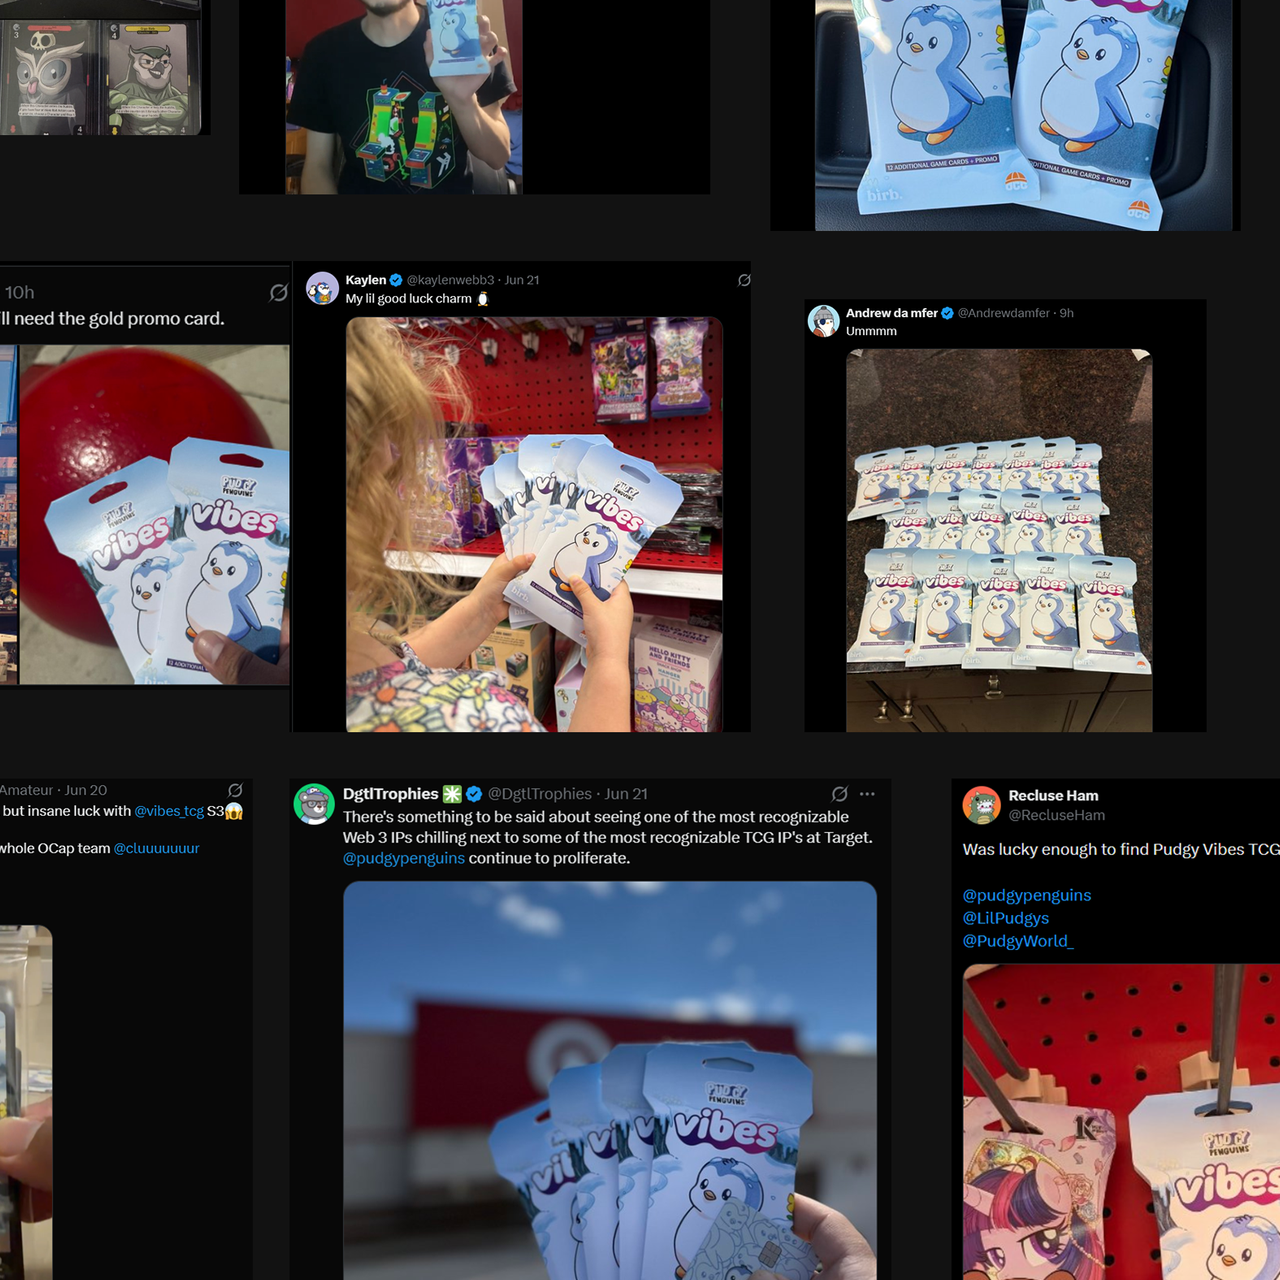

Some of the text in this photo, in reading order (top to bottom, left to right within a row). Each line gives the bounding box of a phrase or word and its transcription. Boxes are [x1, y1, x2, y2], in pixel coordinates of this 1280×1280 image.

[846, 326, 898, 337] Ummmm
[962, 910, 1050, 928] @LilPudgys
[1209, 1145, 1250, 1156] PENGUINS
